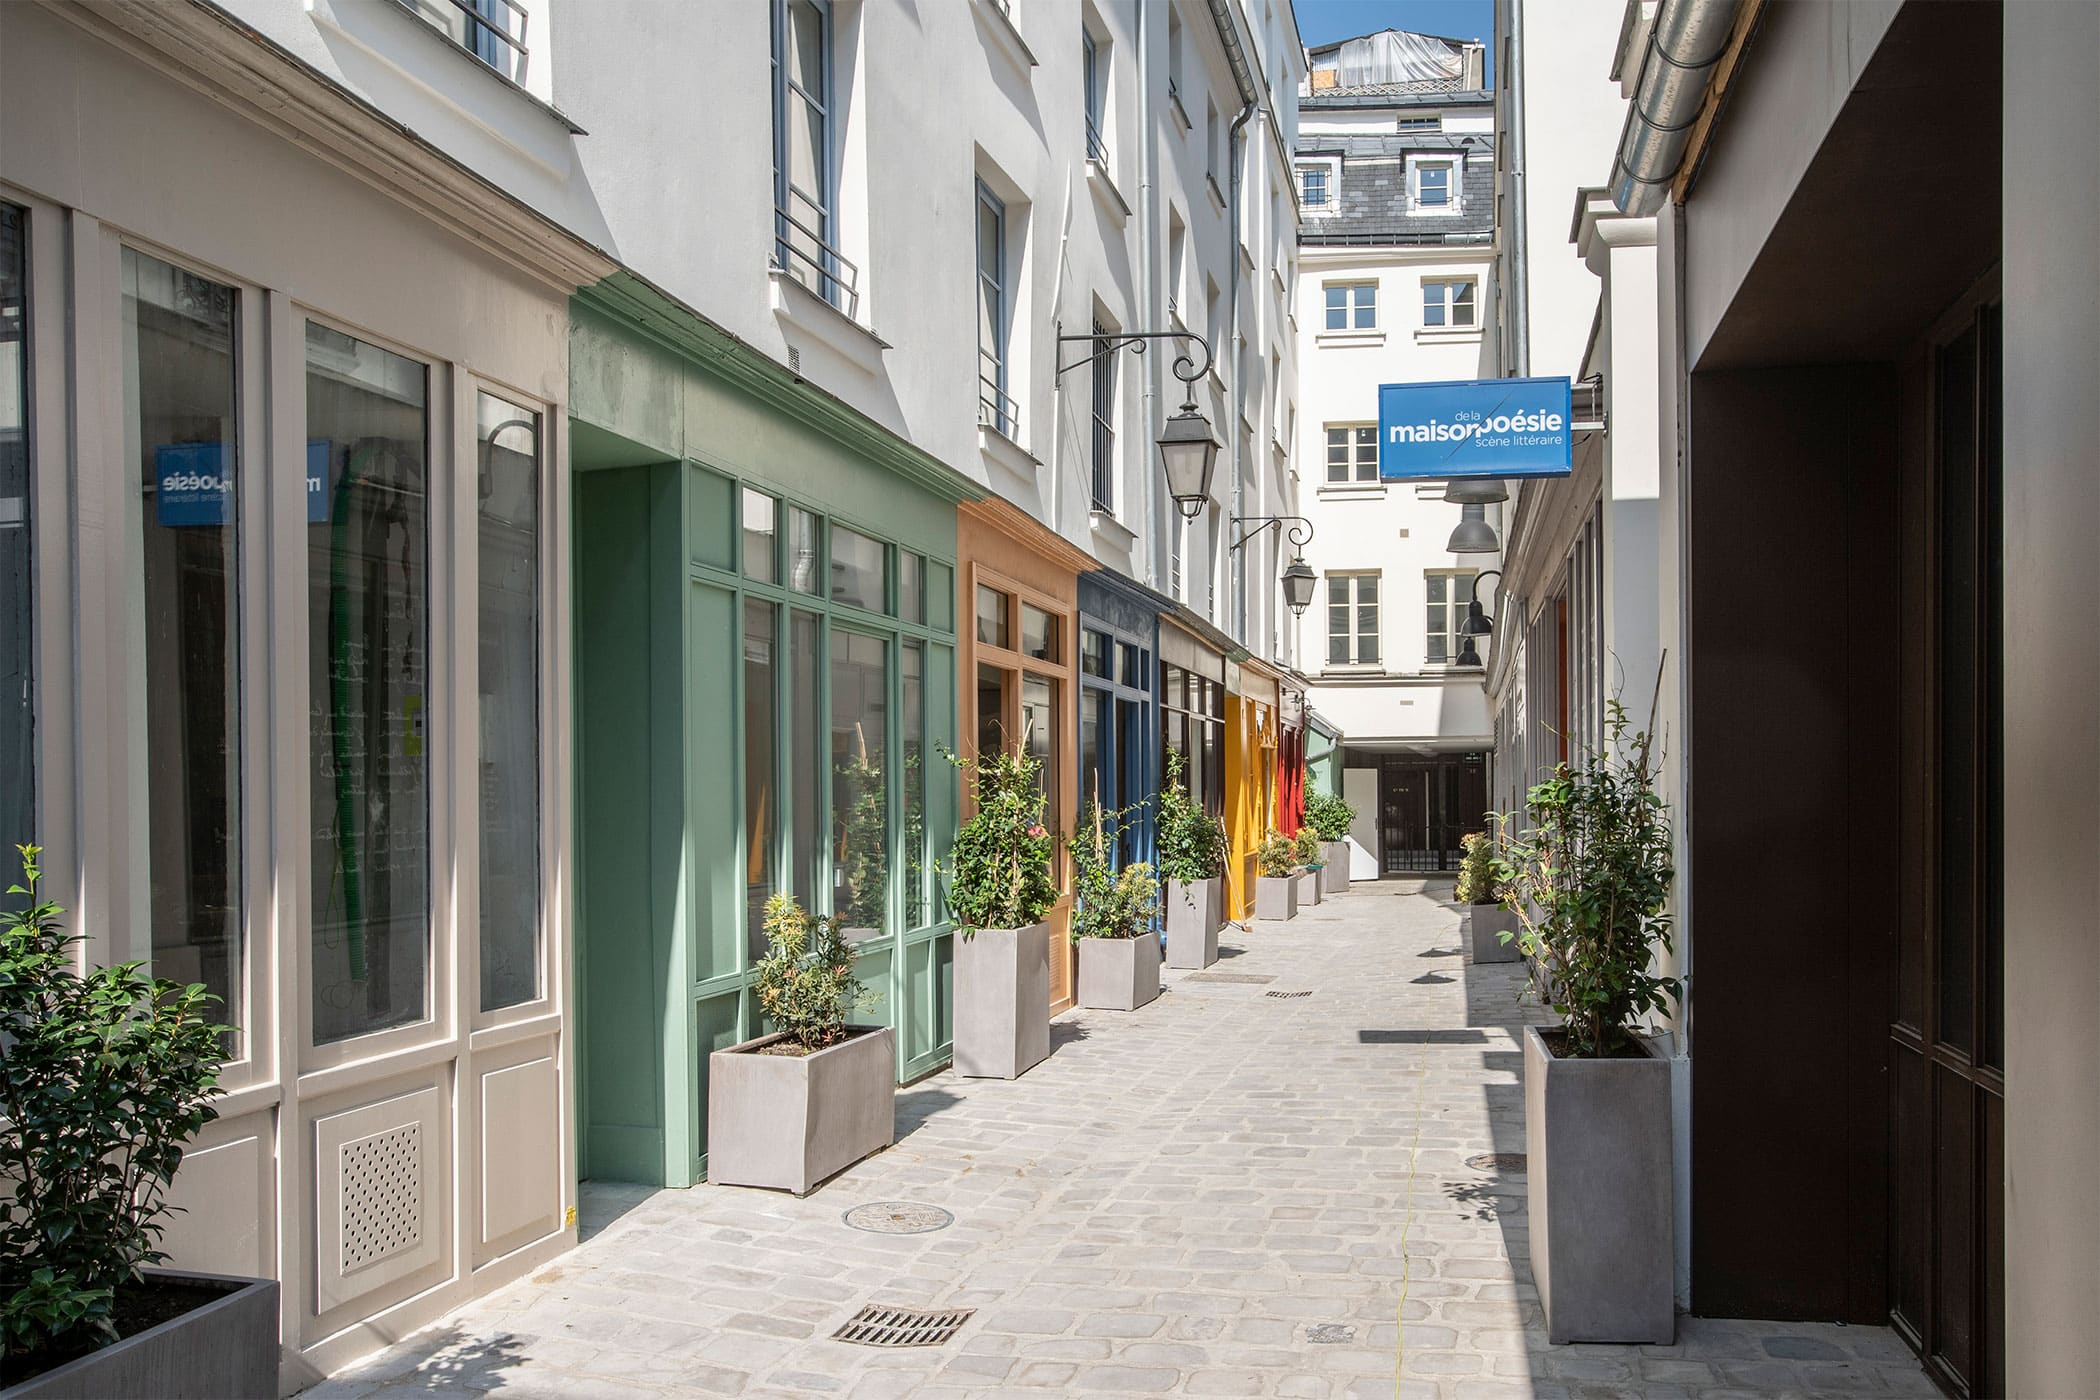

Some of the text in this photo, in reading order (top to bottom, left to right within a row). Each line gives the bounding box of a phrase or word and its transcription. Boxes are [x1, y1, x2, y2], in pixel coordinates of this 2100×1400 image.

[1455, 411, 1480, 421] de la
[1390, 409, 1562, 443] maison poésie
[1475, 435, 1562, 447] scène littéraire
